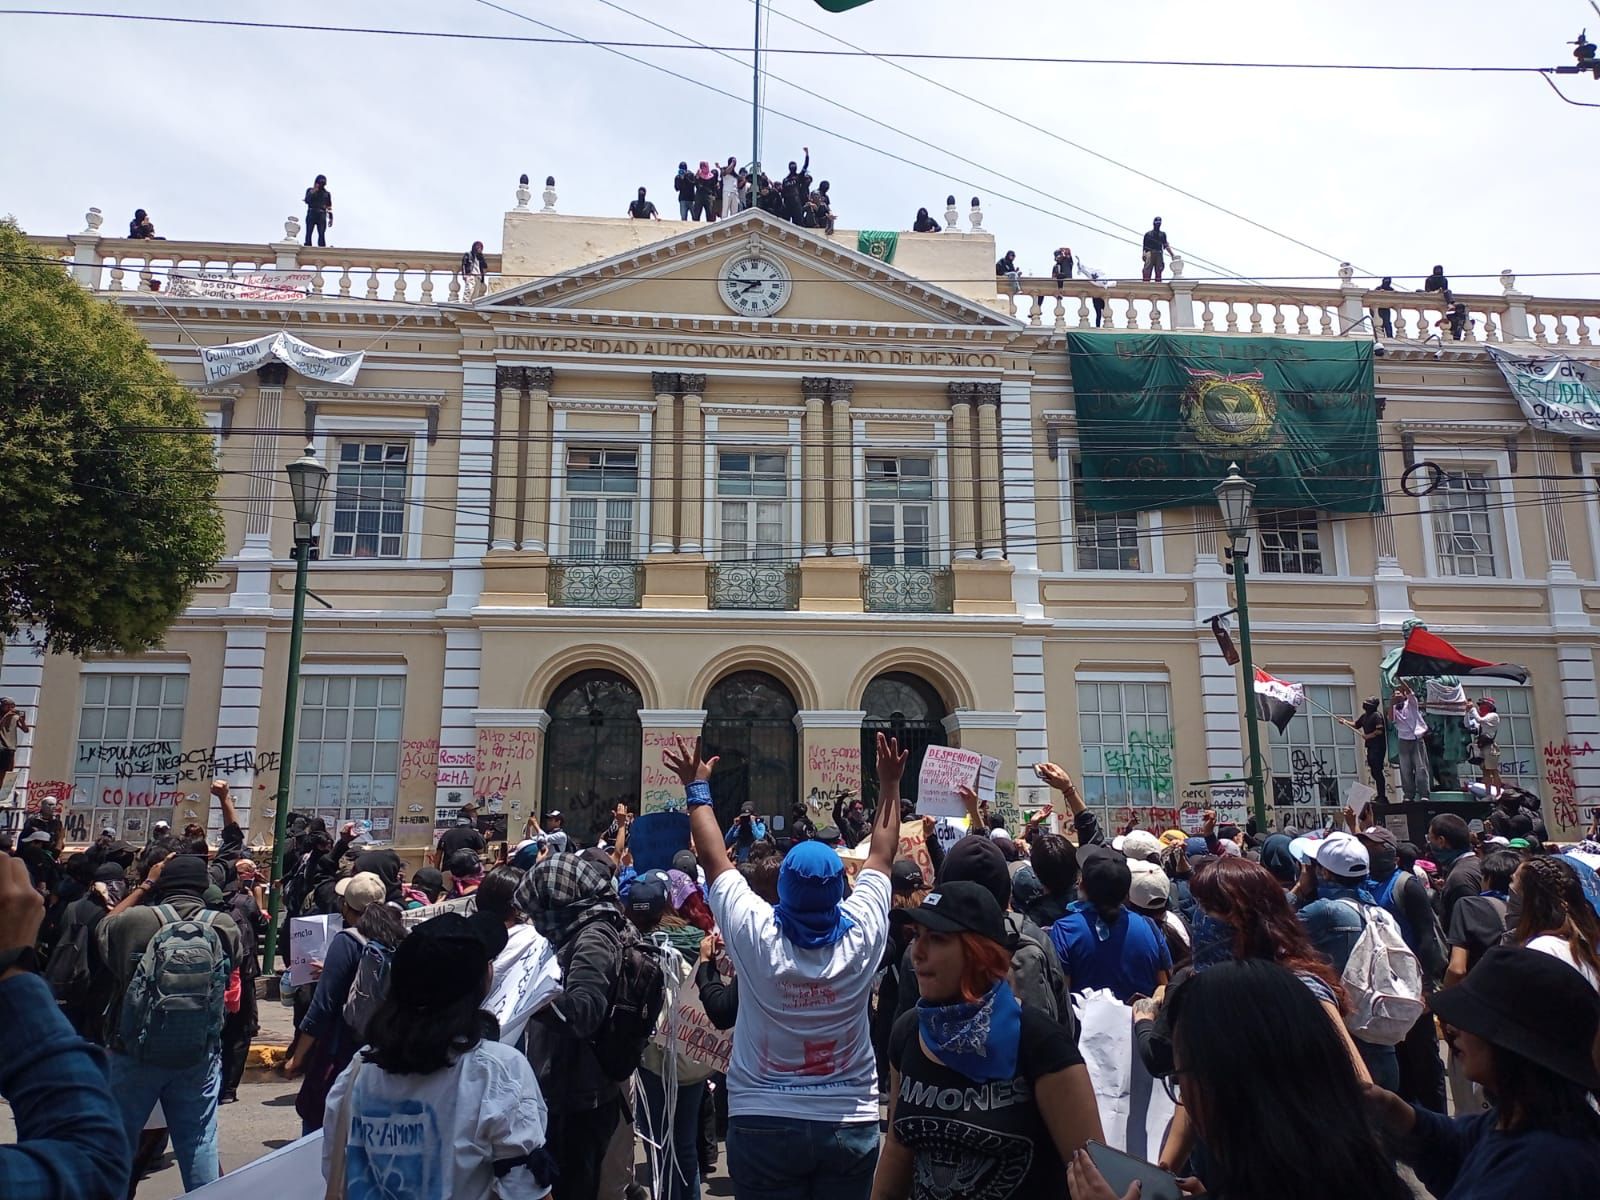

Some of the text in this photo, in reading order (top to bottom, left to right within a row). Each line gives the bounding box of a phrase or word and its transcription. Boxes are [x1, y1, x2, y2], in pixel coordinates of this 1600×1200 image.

[502, 335, 996, 368] UNIVERSIDAD AUTONOMA DEL ESTADO DE MEXICO
[210, 362, 232, 380] HOY
[899, 1076, 1029, 1113] AMONES
